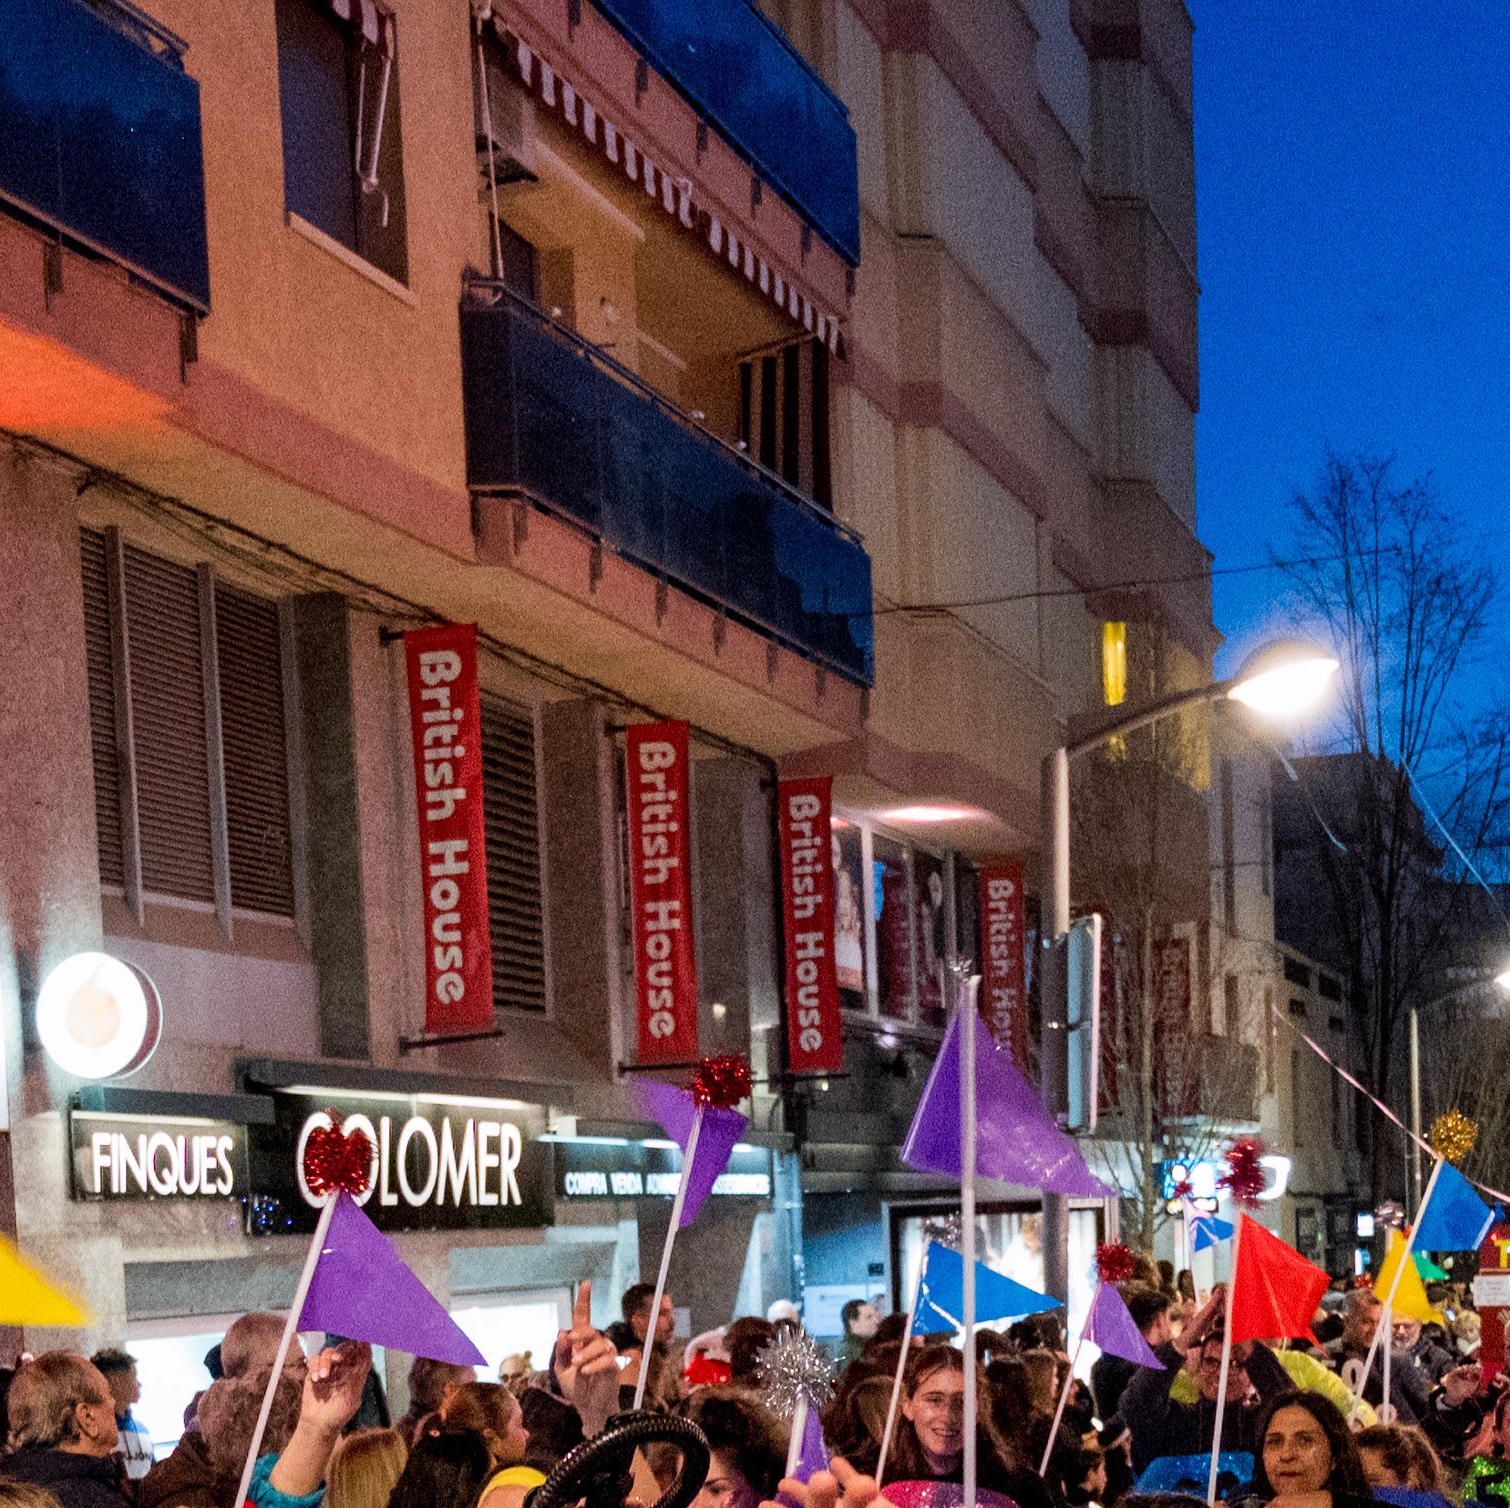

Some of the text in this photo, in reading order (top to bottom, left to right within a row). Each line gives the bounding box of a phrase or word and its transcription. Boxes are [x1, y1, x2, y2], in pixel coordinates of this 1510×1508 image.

[418, 649, 470, 1005] British House
[637, 741, 683, 1041] British House
[788, 794, 825, 1054] British House
[987, 879, 1016, 978] British
[92, 1130, 234, 1196] FINQUES
